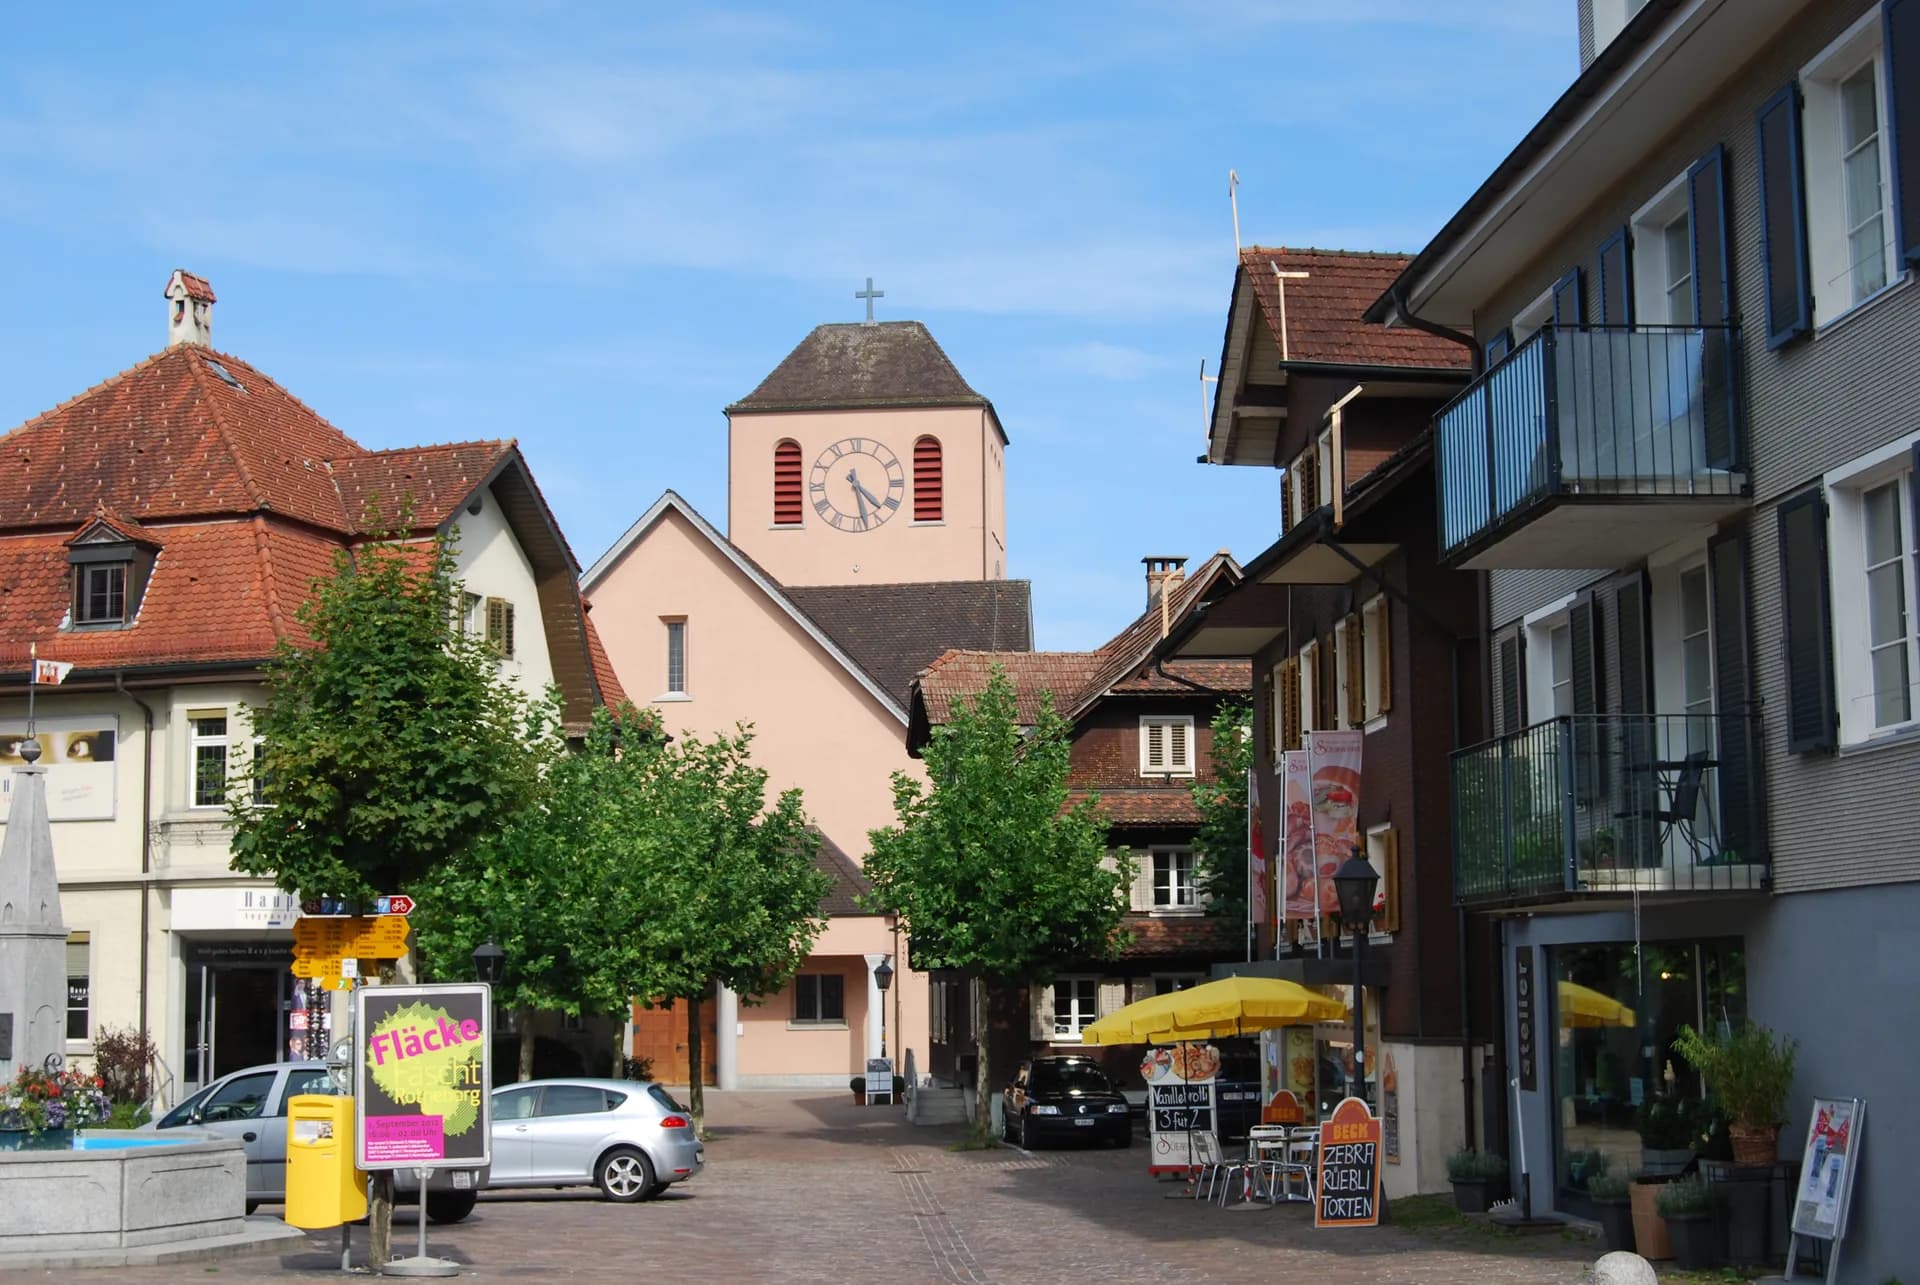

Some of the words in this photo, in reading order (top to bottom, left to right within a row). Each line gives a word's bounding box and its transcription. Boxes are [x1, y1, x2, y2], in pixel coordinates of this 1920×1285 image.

[245, 891, 293, 912] Haup
[1518, 961, 1530, 1075] atelier
[370, 1016, 479, 1066] Fläcke
[376, 1119, 417, 1129] September
[1160, 1109, 1171, 1128] 3
[1173, 1111, 1188, 1130] für
[1190, 1109, 1201, 1128] 2
[1333, 1122, 1369, 1140] BECK
[1322, 1143, 1375, 1165] ZEBRA
[1322, 1166, 1370, 1191] RÜEBLI
[1321, 1196, 1372, 1217] TORTEN
